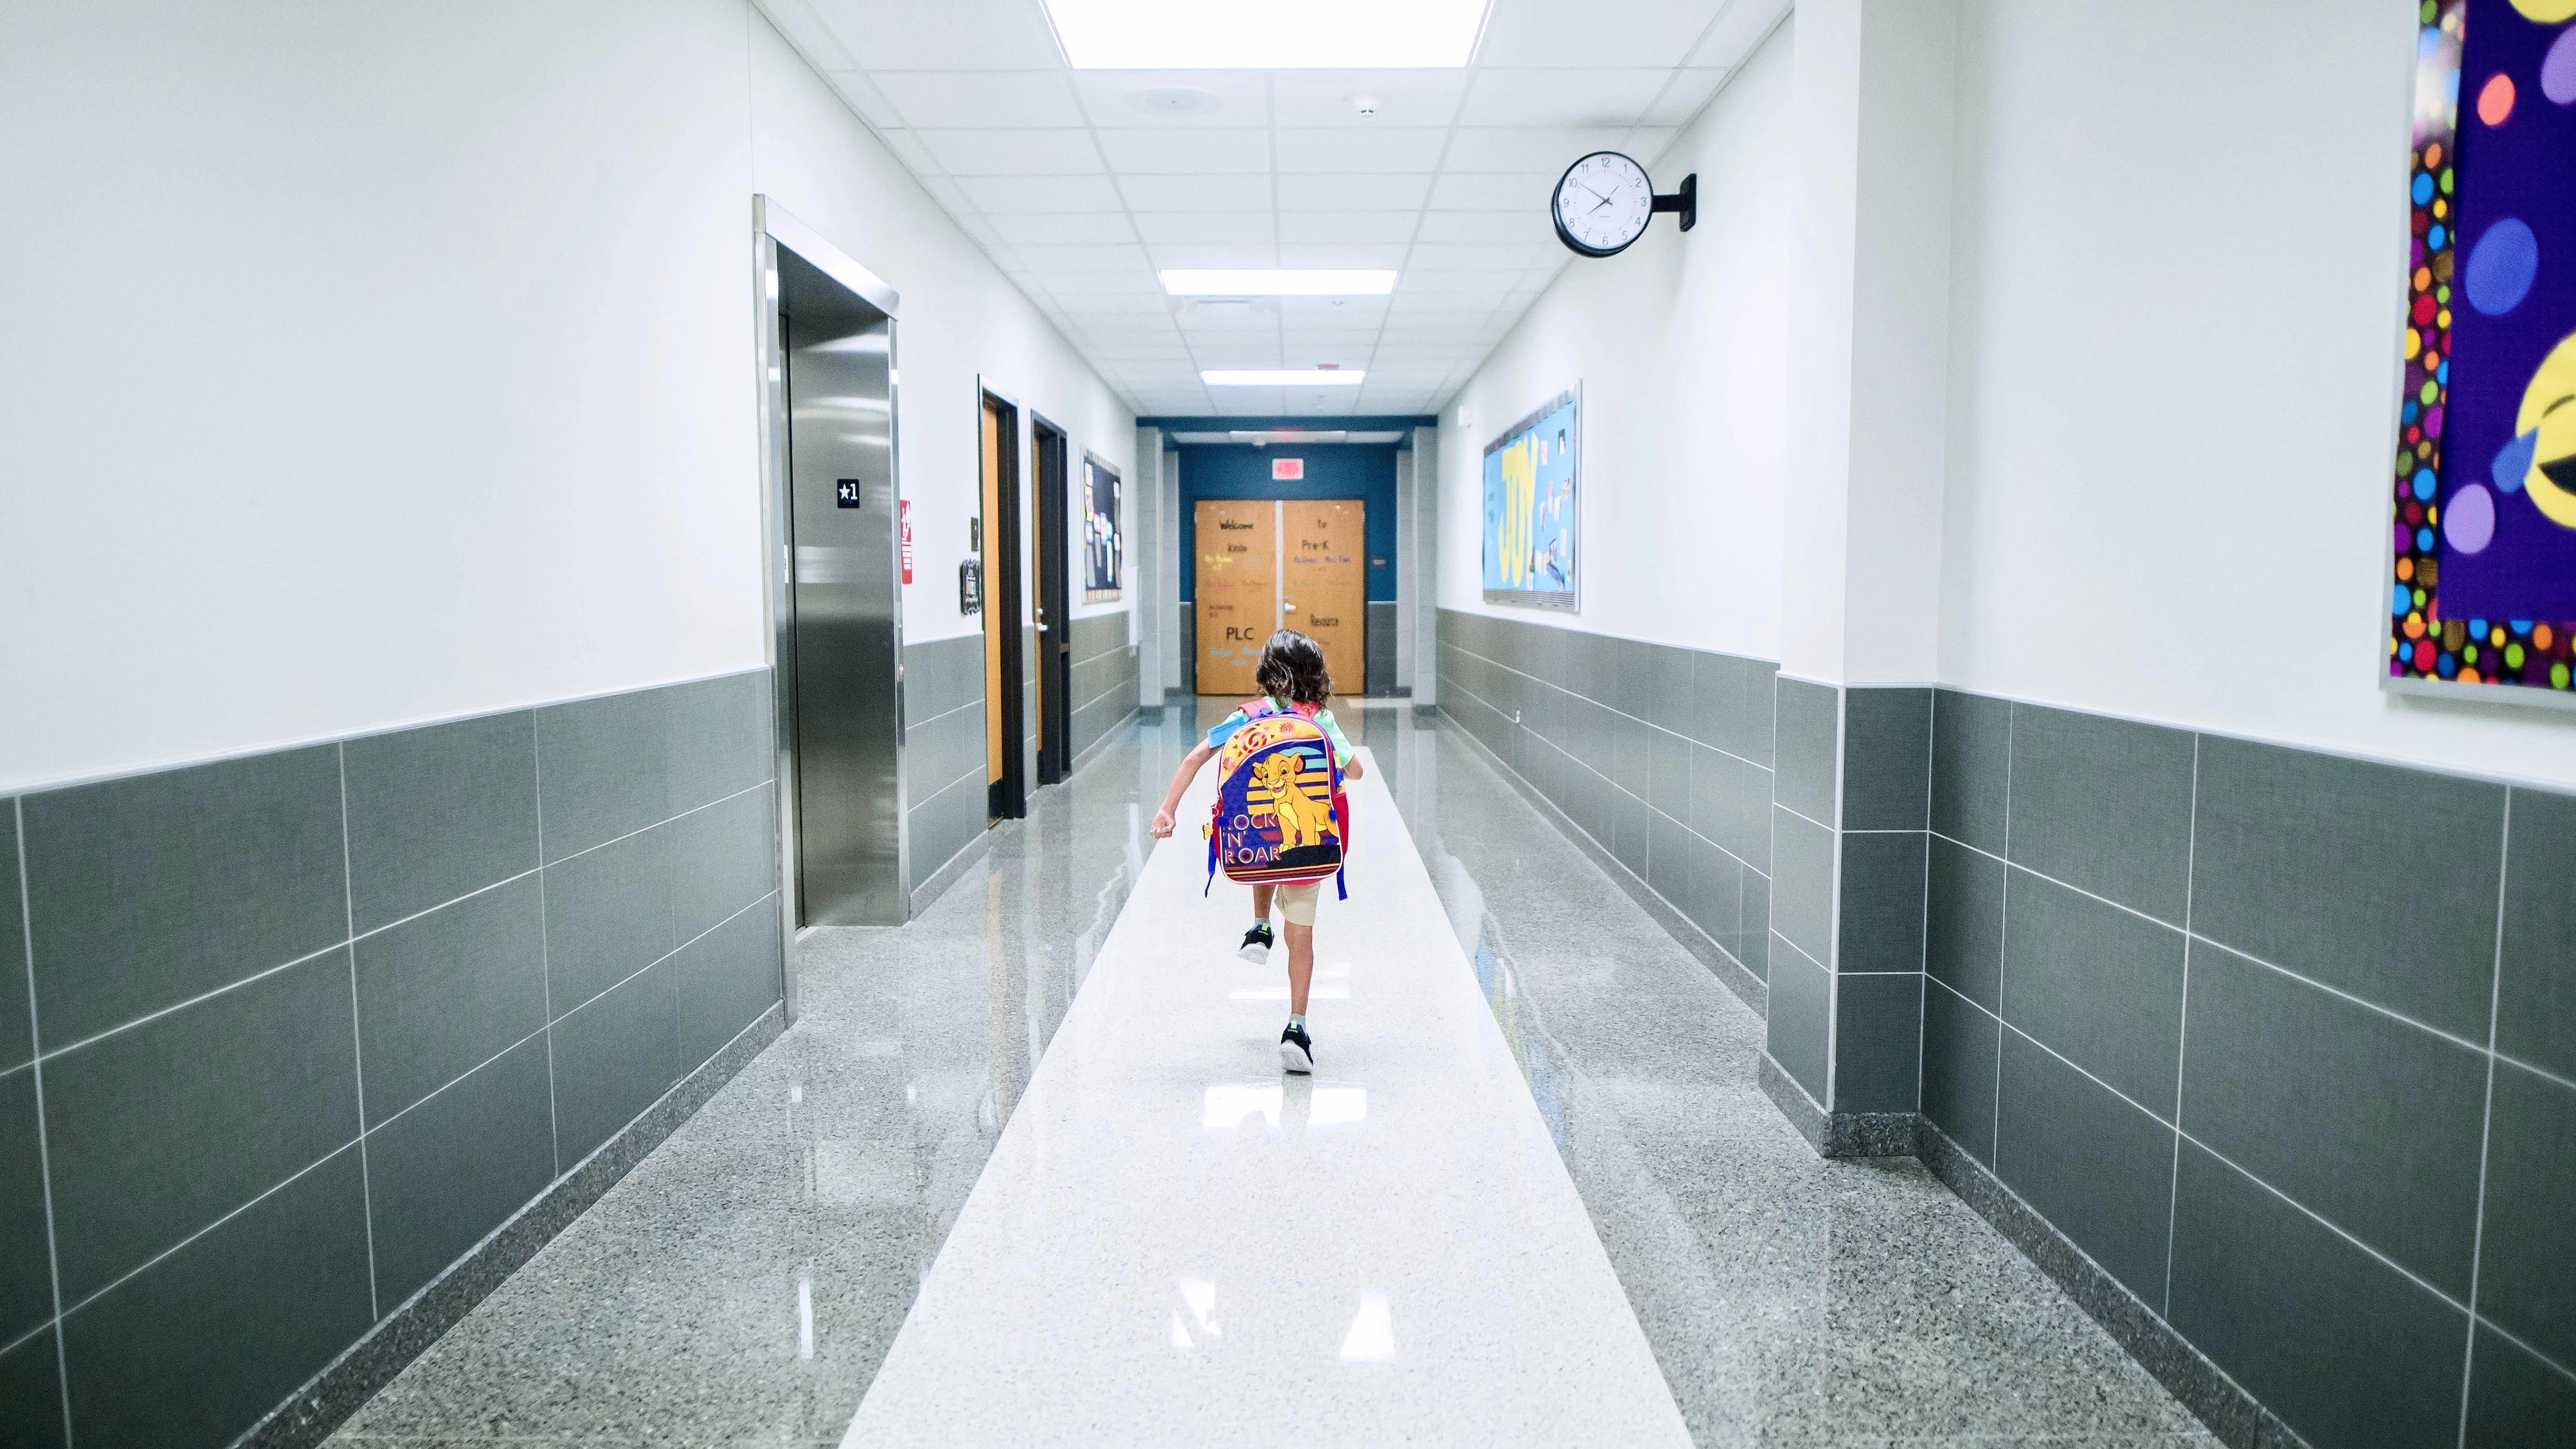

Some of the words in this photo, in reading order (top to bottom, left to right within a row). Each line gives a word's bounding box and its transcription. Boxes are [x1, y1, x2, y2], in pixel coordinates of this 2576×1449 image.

[1601, 158, 1610, 167] 12
[1581, 164, 1589, 173] 11
[1624, 164, 1627, 173] 1
[1568, 177, 1577, 188] 10
[1636, 177, 1641, 187] 2
[1563, 198, 1569, 207] 9
[1640, 197, 1647, 207] 3
[1569, 217, 1575, 228] 8
[1635, 216, 1641, 226] 4
[1583, 231, 1589, 241] 7
[1621, 230, 1627, 240] 5
[1603, 236, 1608, 246] 6
[850, 483, 858, 500] 1
[1499, 433, 1539, 586] JOY
[1219, 519, 1254, 530] Welcome
[1302, 540, 1330, 551] Pre-K
[1226, 626, 1254, 640] PLC
[1223, 813, 1277, 830] OCK
[1225, 846, 1281, 864] ROAR
